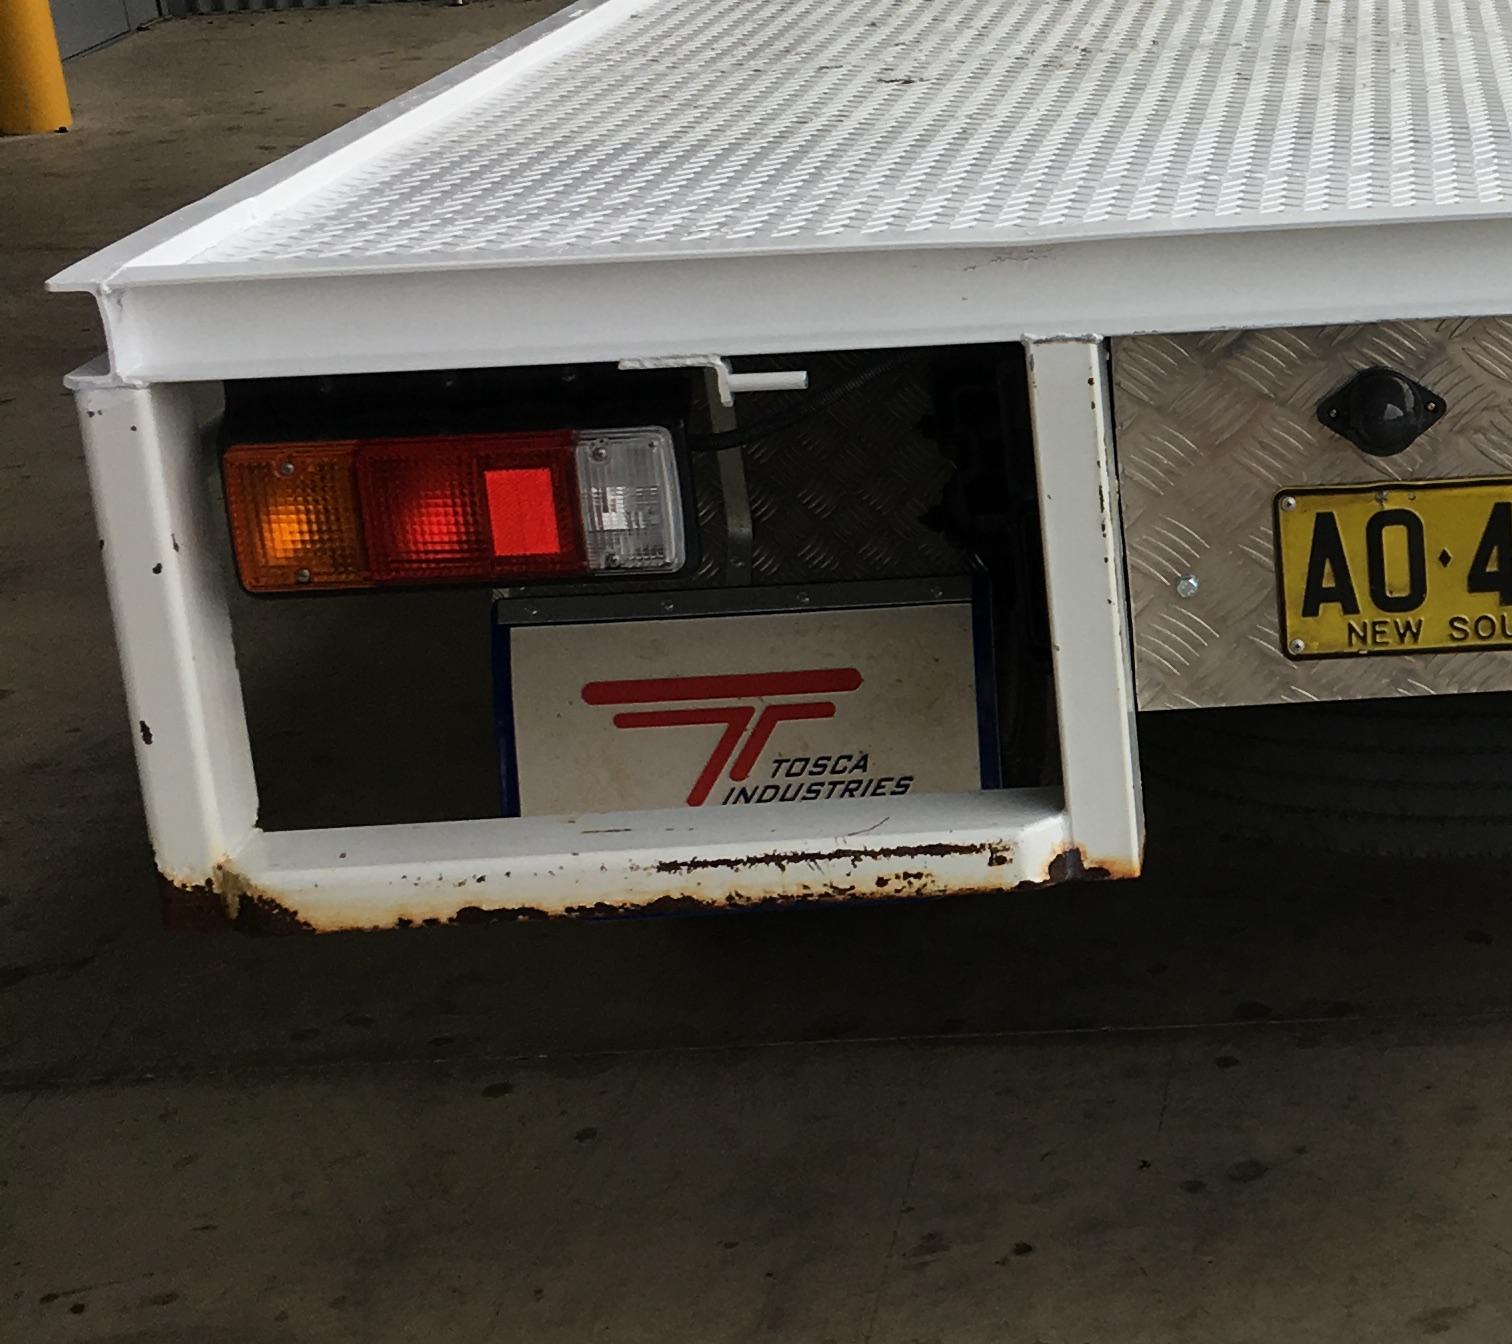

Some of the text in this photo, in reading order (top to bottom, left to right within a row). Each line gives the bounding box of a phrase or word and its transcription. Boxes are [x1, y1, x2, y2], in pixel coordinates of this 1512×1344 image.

[1346, 620, 1423, 646] NEW
[771, 754, 870, 778] TOSCA
[721, 775, 914, 805] INDUSTRIES
